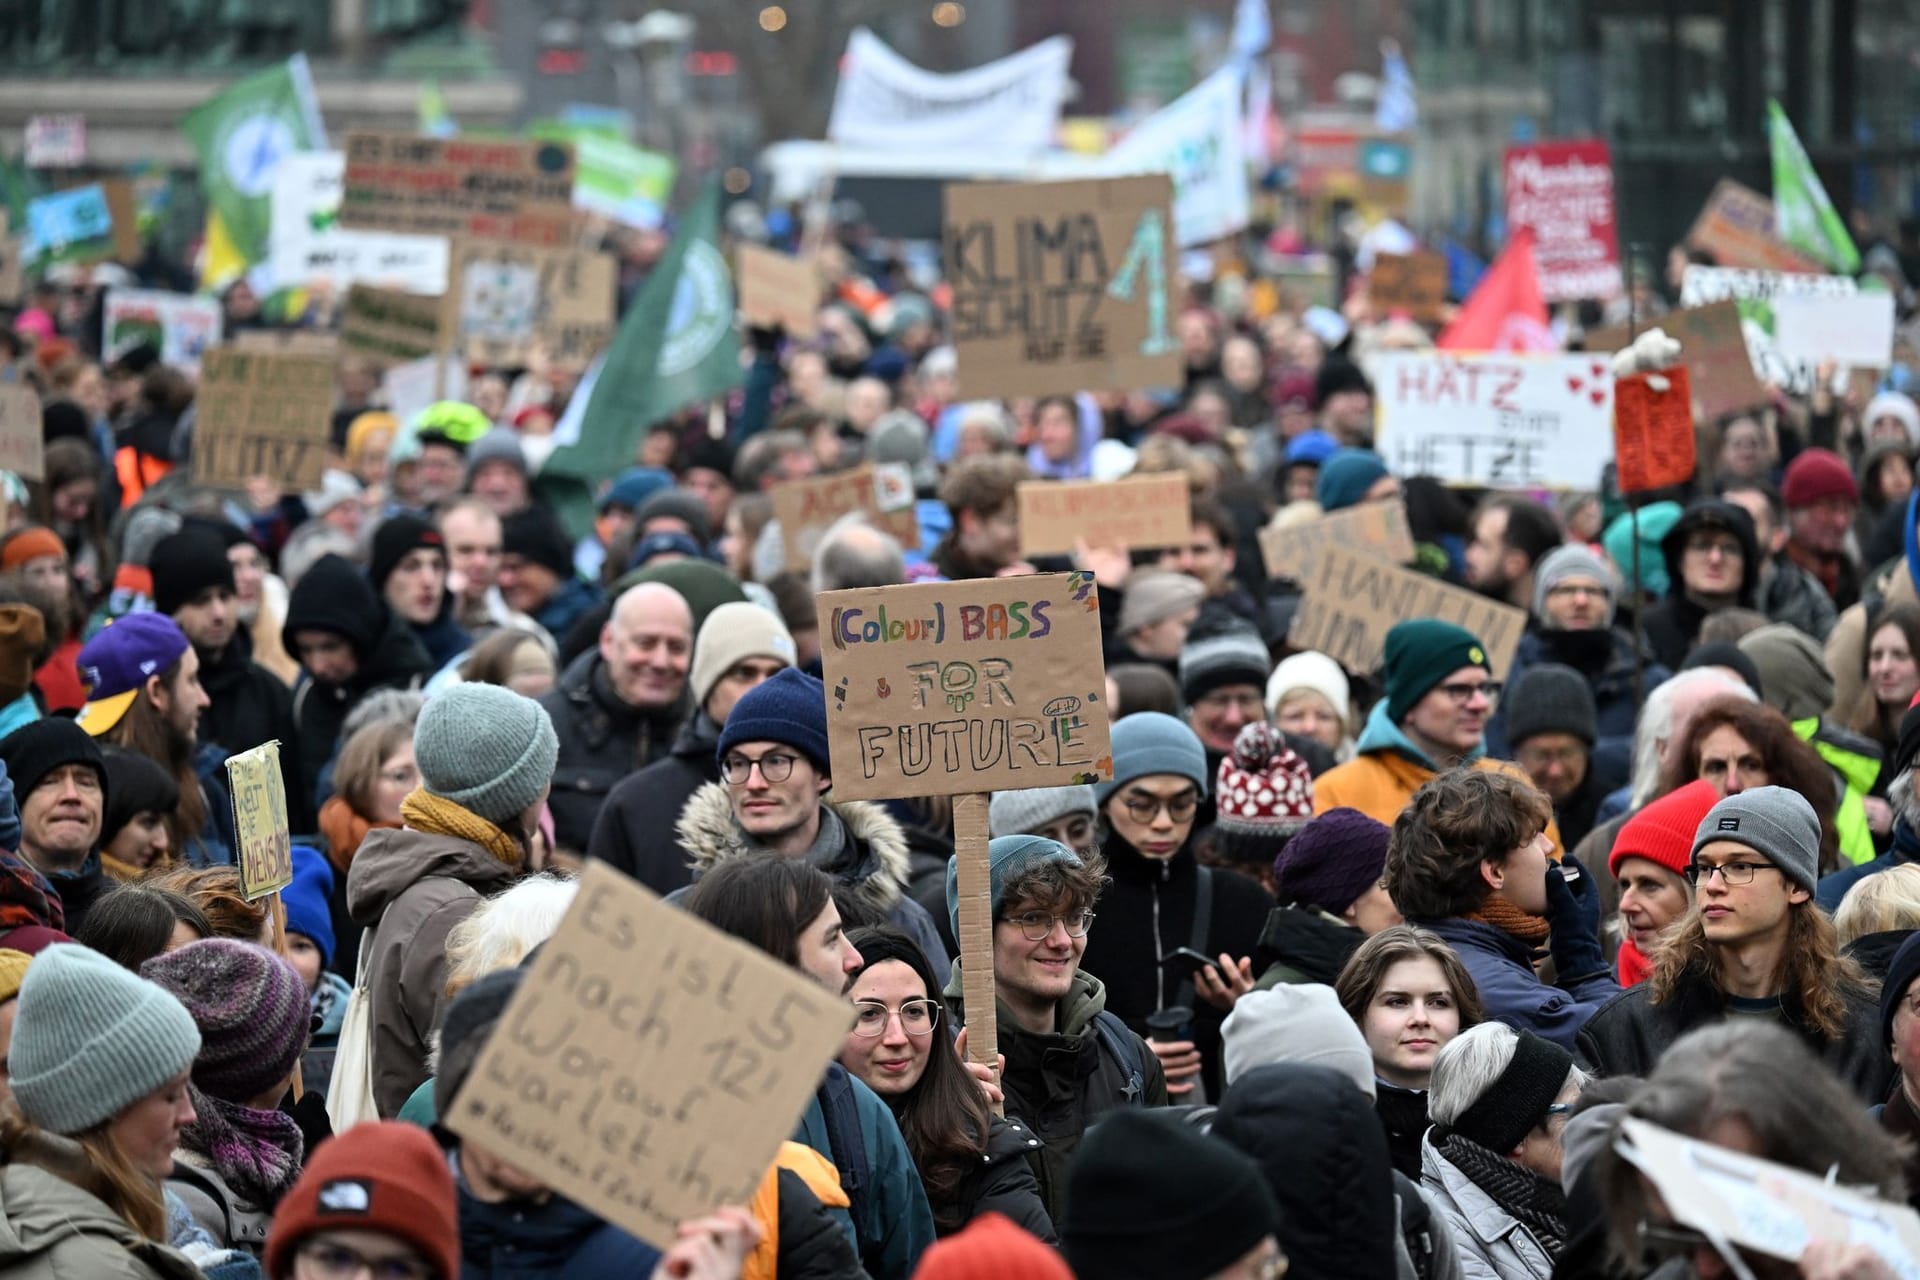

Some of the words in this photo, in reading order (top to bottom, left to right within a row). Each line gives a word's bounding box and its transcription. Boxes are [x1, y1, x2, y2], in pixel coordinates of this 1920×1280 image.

[943, 213, 1109, 289] KLIMA
[1106, 207, 1180, 356] 1
[954, 284, 1106, 341] SCHUTZ
[1396, 434, 1546, 483] HETZE
[831, 601, 945, 650] (Colour)
[959, 600, 1051, 641] BASS
[906, 658, 1016, 711] FOR
[858, 716, 1093, 779] FUTURE
[580, 882, 637, 951] Es
[661, 948, 746, 1011] ist
[748, 997, 822, 1052] 5
[542, 951, 673, 1050] nach
